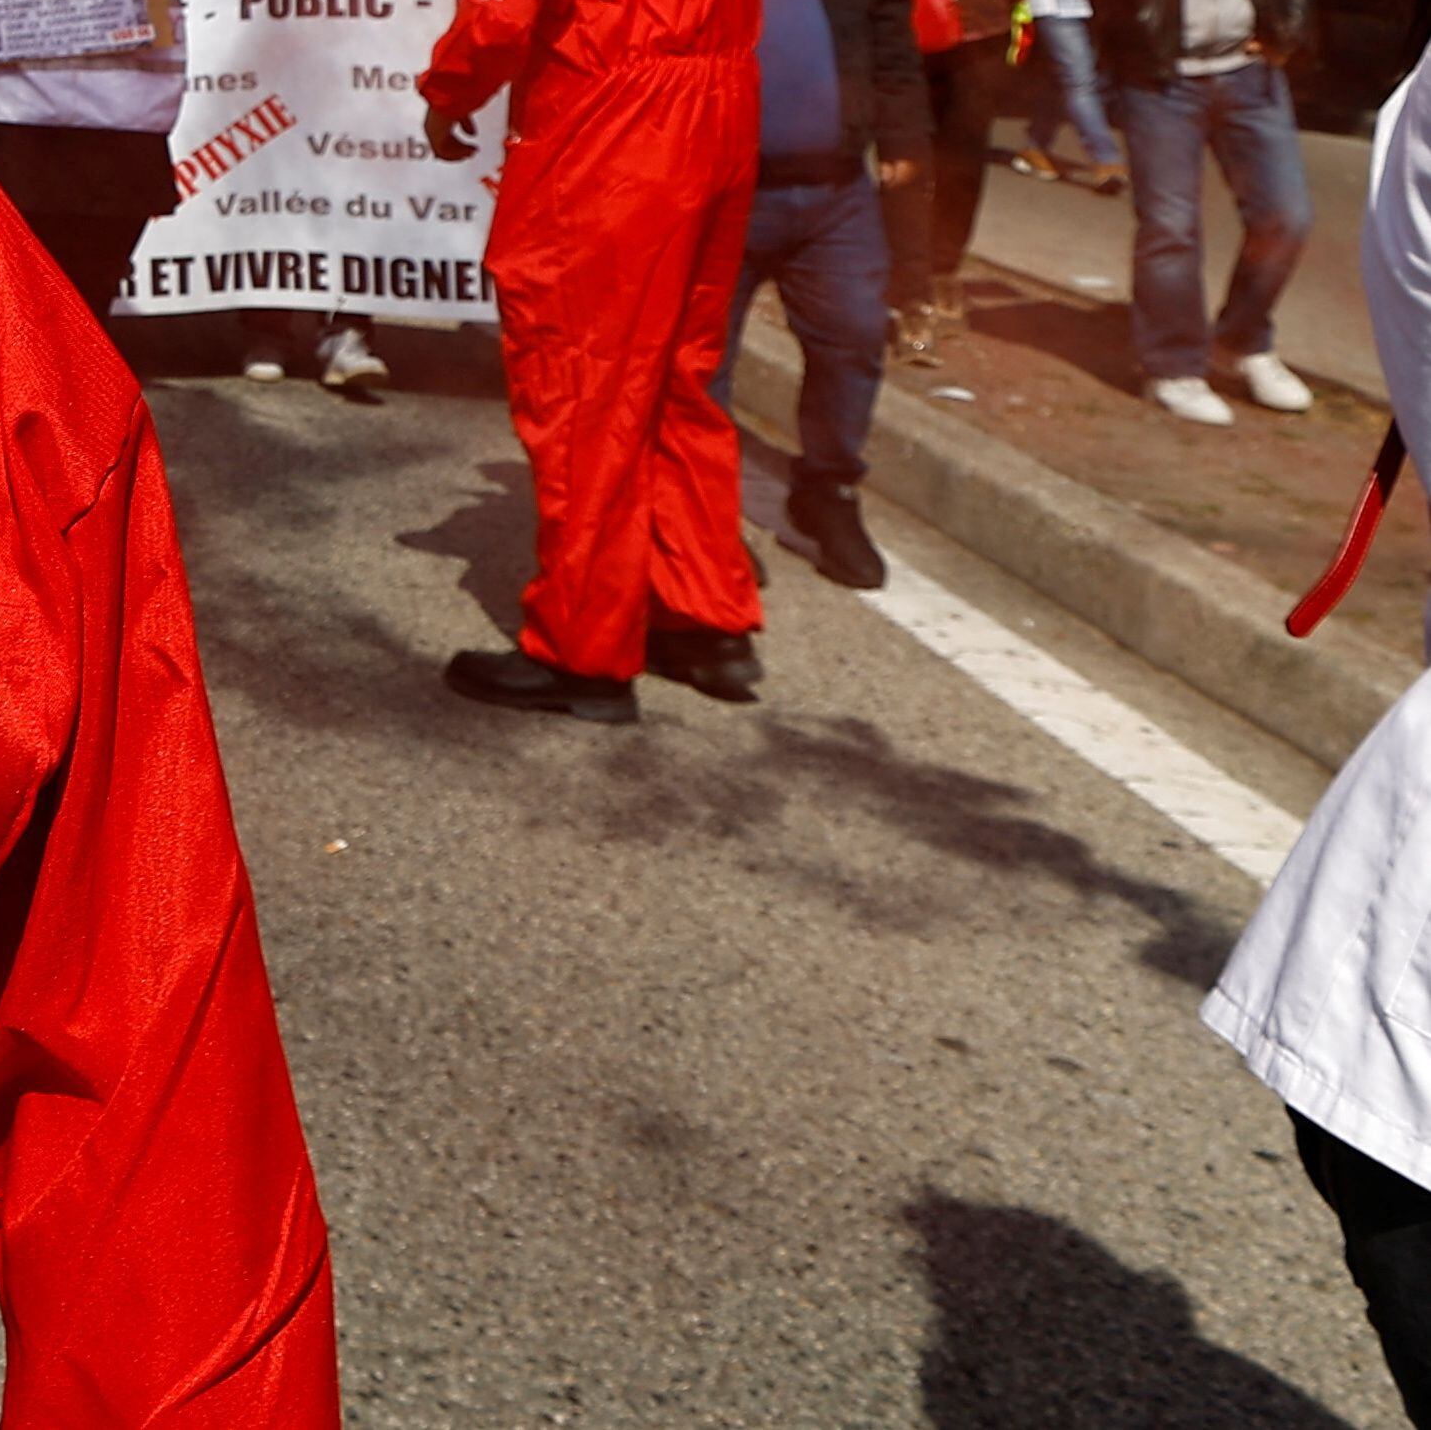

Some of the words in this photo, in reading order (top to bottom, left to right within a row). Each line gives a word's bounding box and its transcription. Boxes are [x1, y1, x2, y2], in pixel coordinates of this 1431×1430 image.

[183, 68, 259, 93] nes
[306, 130, 436, 162] Vésub
[214, 190, 332, 219] Vallée
[345, 193, 393, 220] du
[408, 196, 477, 223] Var
[150, 256, 196, 297] ET
[204, 251, 331, 293] VIVRE
